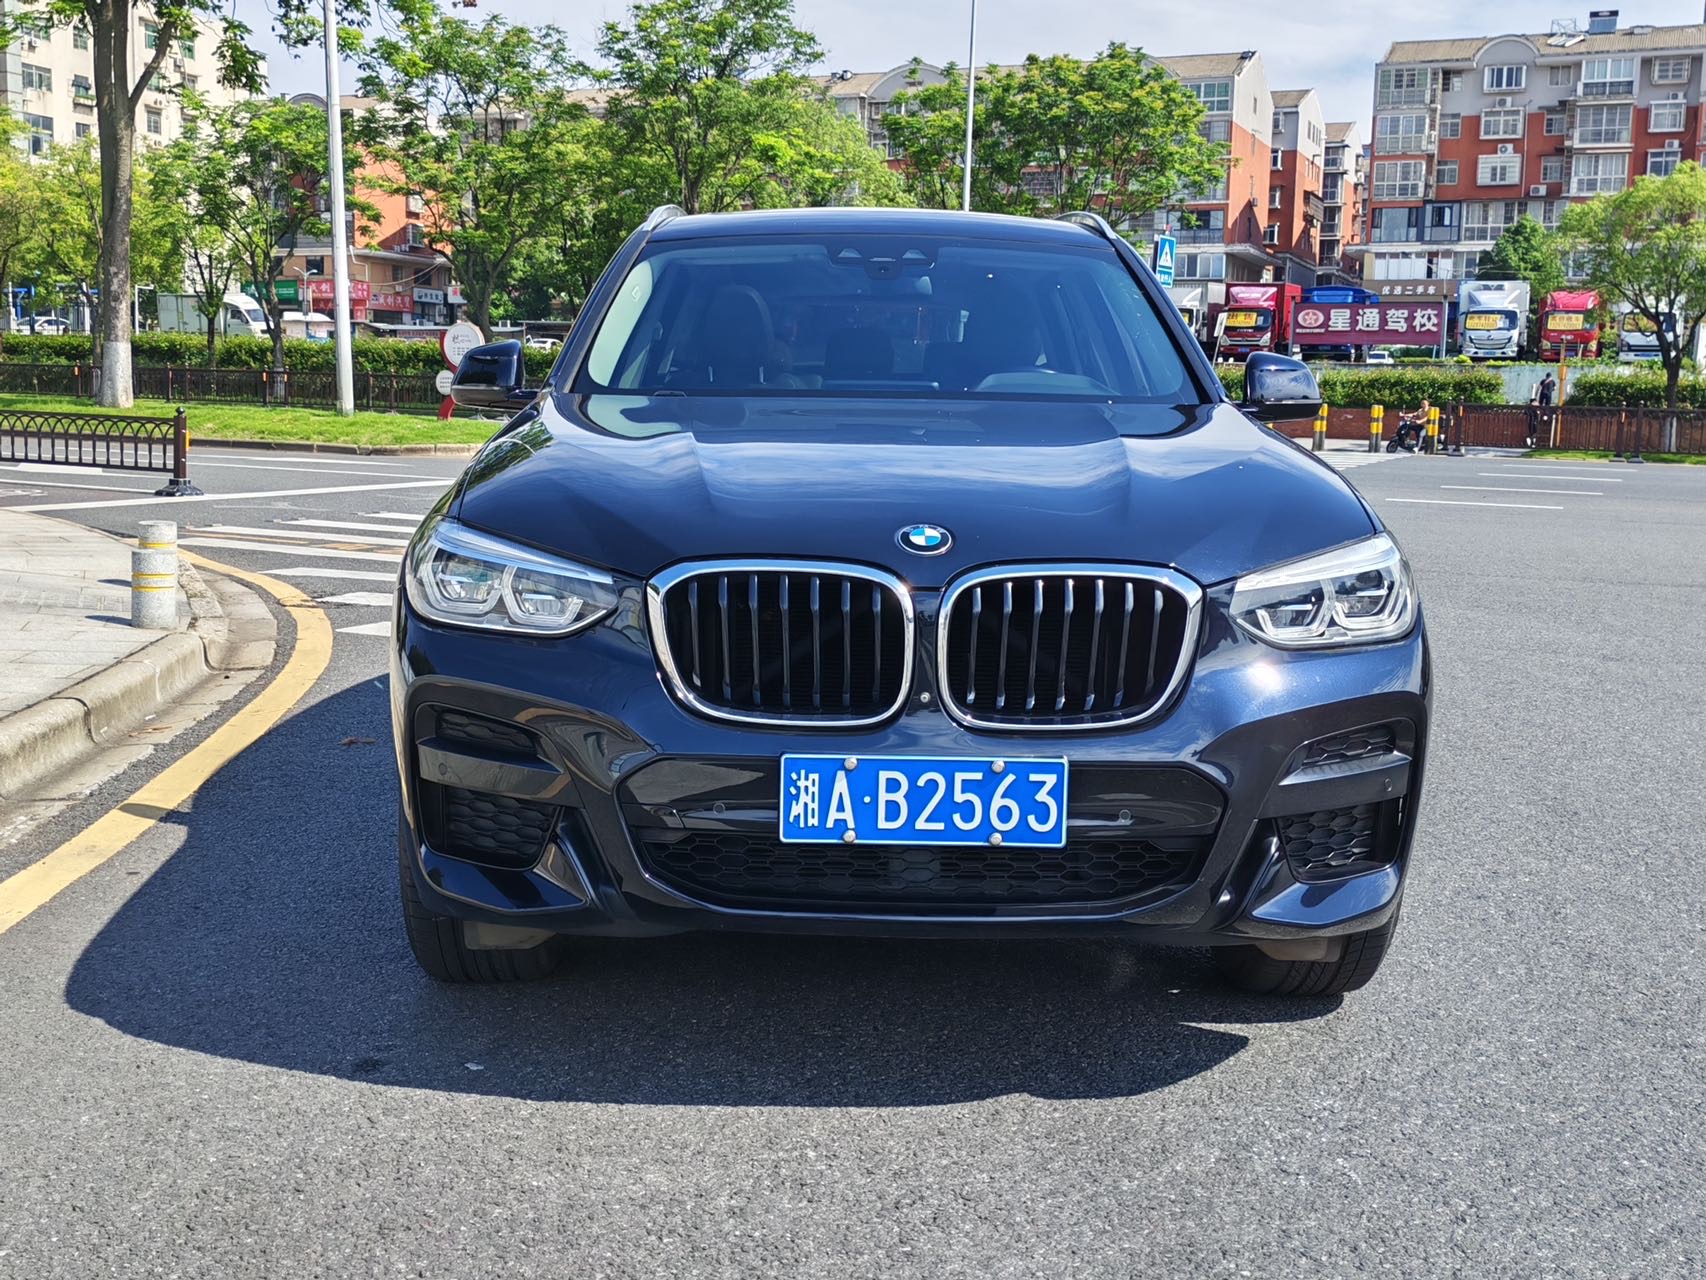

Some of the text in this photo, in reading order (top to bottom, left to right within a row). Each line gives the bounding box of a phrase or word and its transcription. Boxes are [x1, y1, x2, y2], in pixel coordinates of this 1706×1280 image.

[1382, 285, 1437, 295] 优选二手车
[1328, 308, 1439, 333] 星通驾校
[789, 769, 1059, 833] 湘A·B2563
